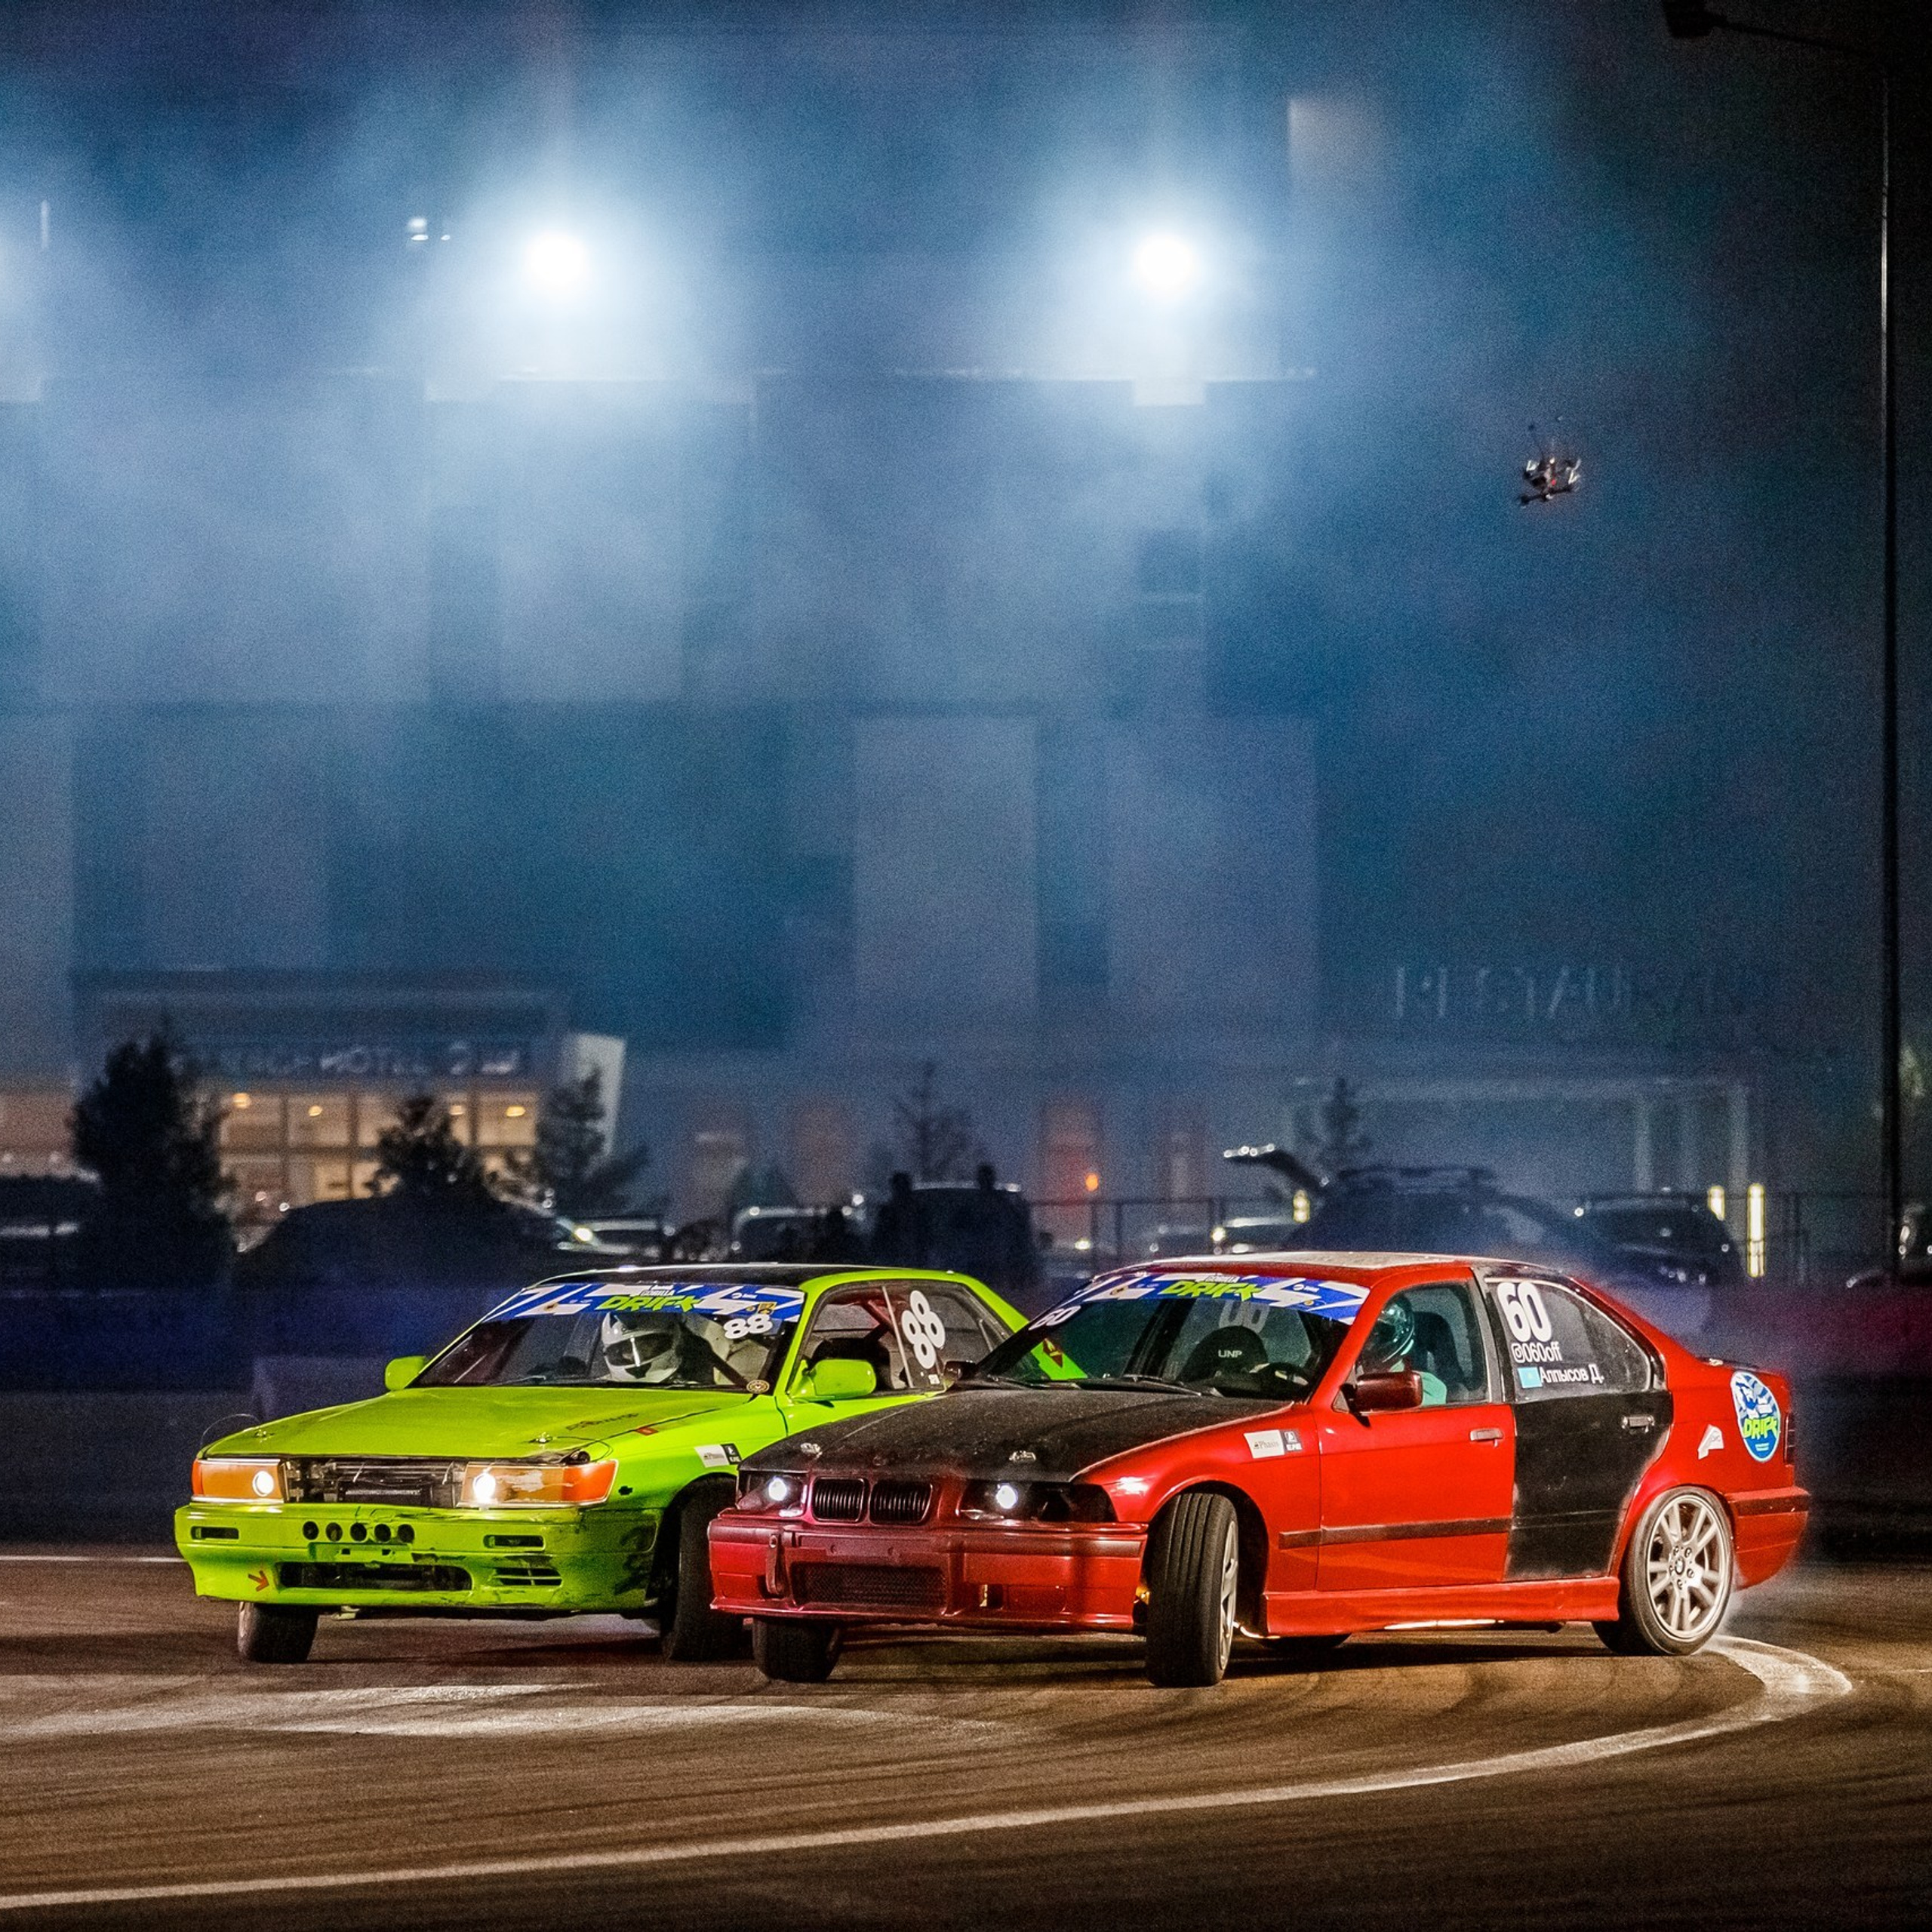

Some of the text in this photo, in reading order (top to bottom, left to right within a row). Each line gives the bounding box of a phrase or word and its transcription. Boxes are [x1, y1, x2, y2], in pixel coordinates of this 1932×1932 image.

[595, 1295, 702, 1312] DRIFT
[1158, 1281, 1263, 1301] DRIFT
[1028, 1306, 1081, 1331] 60
[1497, 1281, 1552, 1342] 60
[723, 1314, 773, 1339] 88
[901, 1290, 946, 1369] 88
